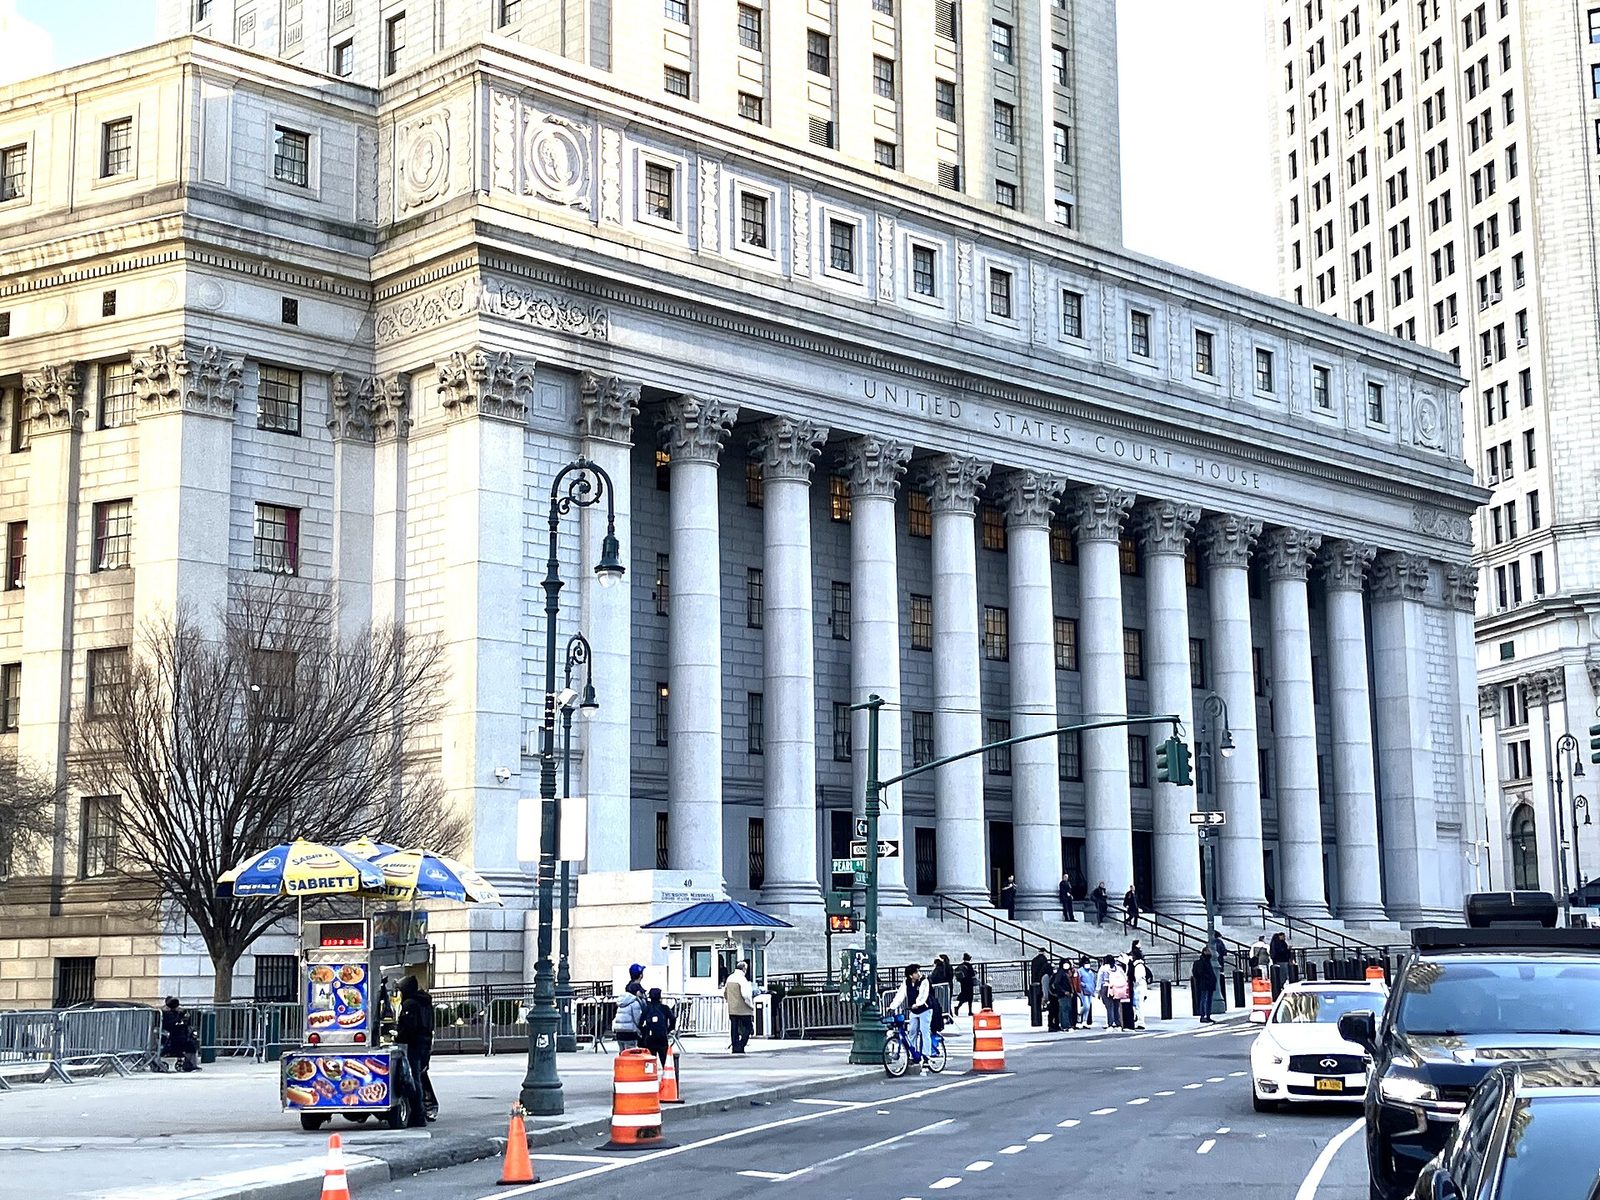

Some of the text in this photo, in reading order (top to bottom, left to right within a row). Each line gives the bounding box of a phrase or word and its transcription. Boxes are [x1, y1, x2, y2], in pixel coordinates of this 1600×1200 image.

[864, 380, 1260, 490] UNITED STATES COURT HOUSE
[833, 861, 853, 871] PEARL
[288, 876, 355, 890] SABRETT
[683, 879, 692, 887] 40
[319, 988, 326, 996] A
